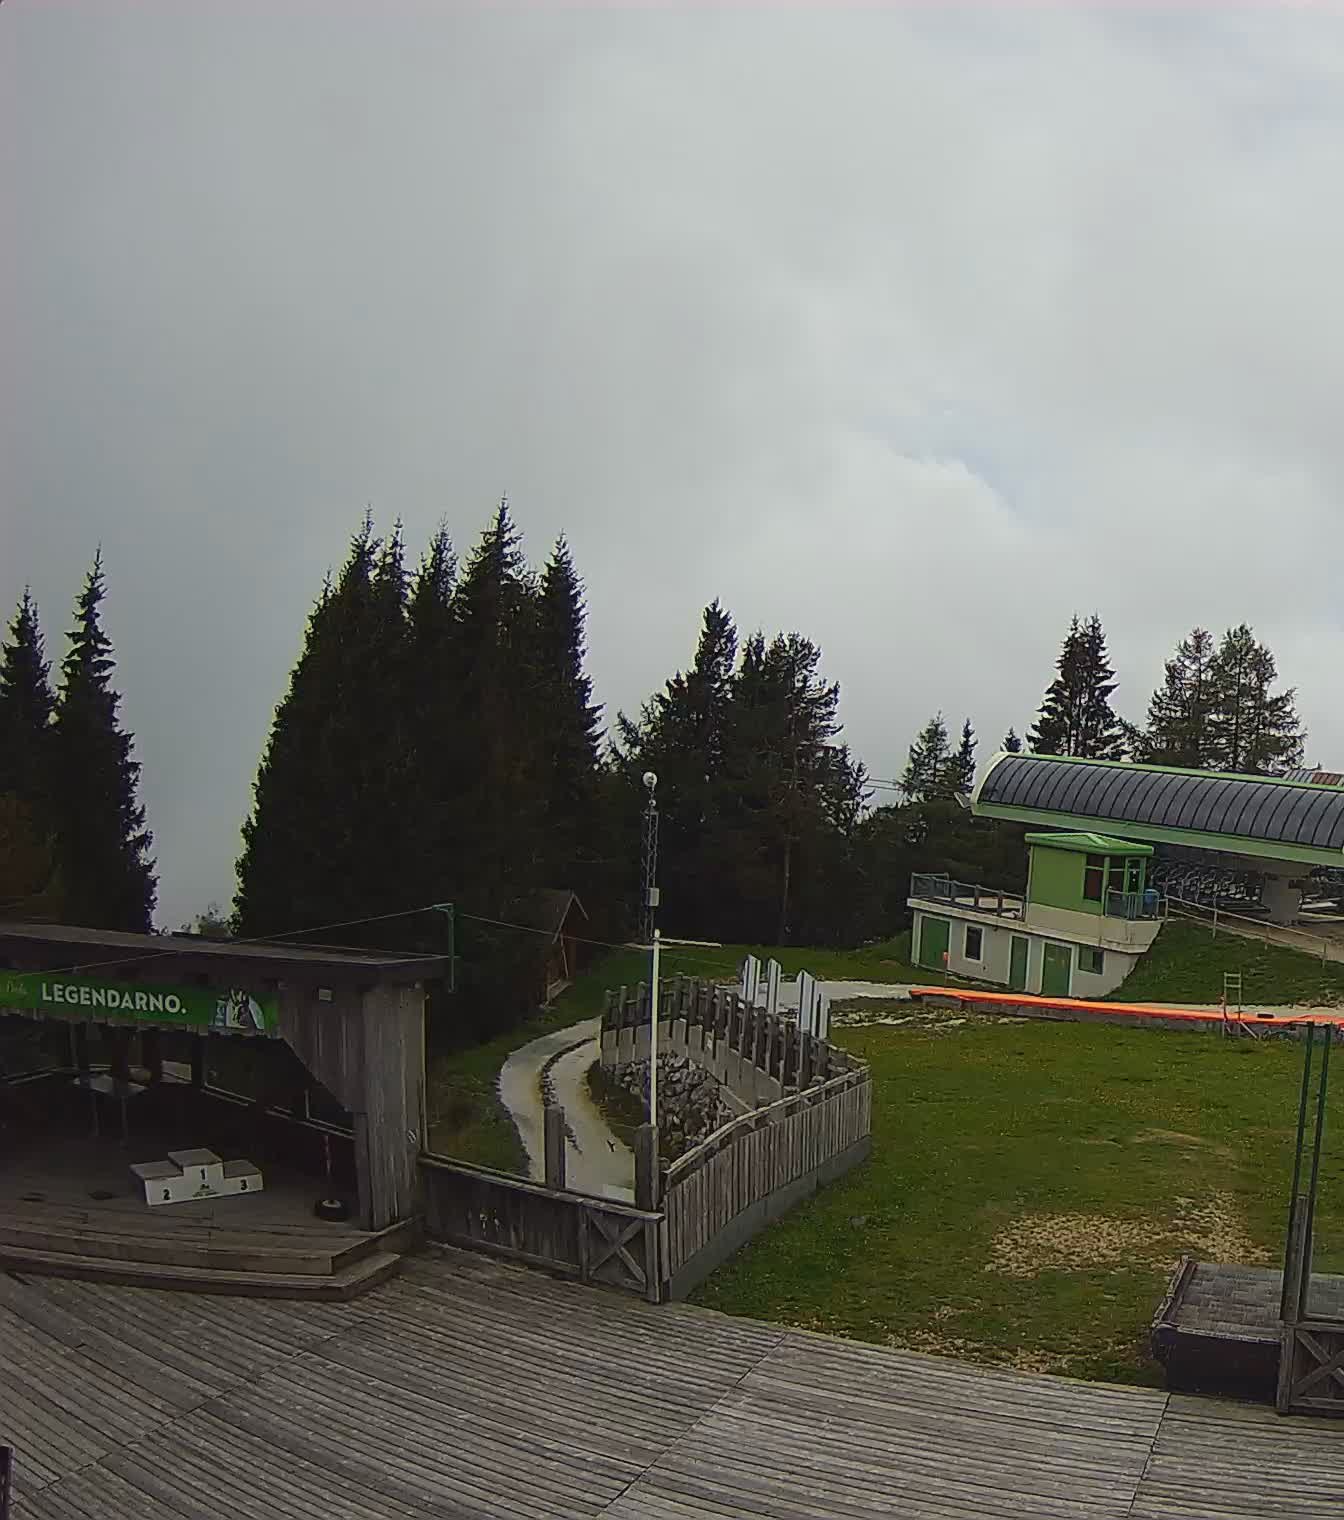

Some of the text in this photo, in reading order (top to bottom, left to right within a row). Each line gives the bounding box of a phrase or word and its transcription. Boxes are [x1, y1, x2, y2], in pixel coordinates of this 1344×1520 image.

[41, 982, 187, 1014] LEGENDARNO.
[200, 1167, 206, 1180] 1
[240, 1179, 248, 1191] 3
[163, 1189, 170, 1200] 2
